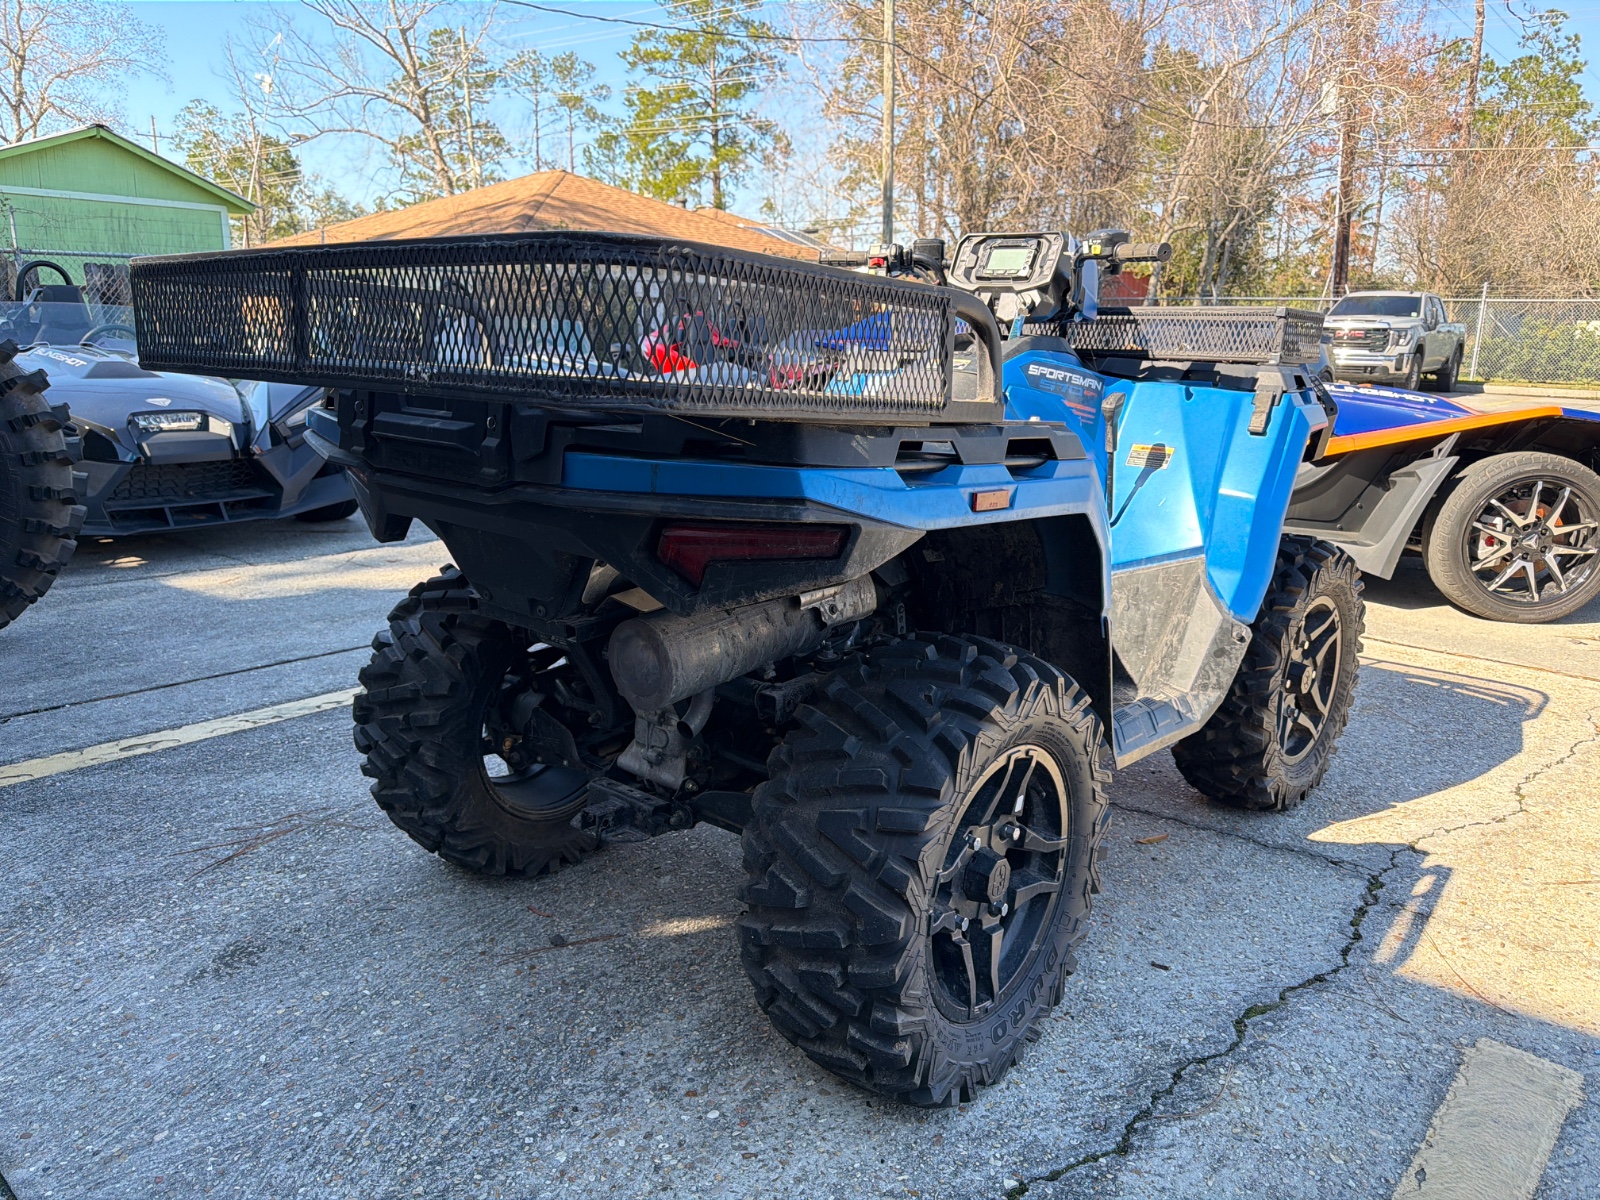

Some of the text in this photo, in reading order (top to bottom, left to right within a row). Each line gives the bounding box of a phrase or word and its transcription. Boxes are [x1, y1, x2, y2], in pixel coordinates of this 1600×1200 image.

[34, 348, 88, 367] SLINGSHOT
[1028, 364, 1102, 391] SPORTSMAN
[1040, 379, 1083, 397] 570
[991, 942, 1058, 1044] DURO
